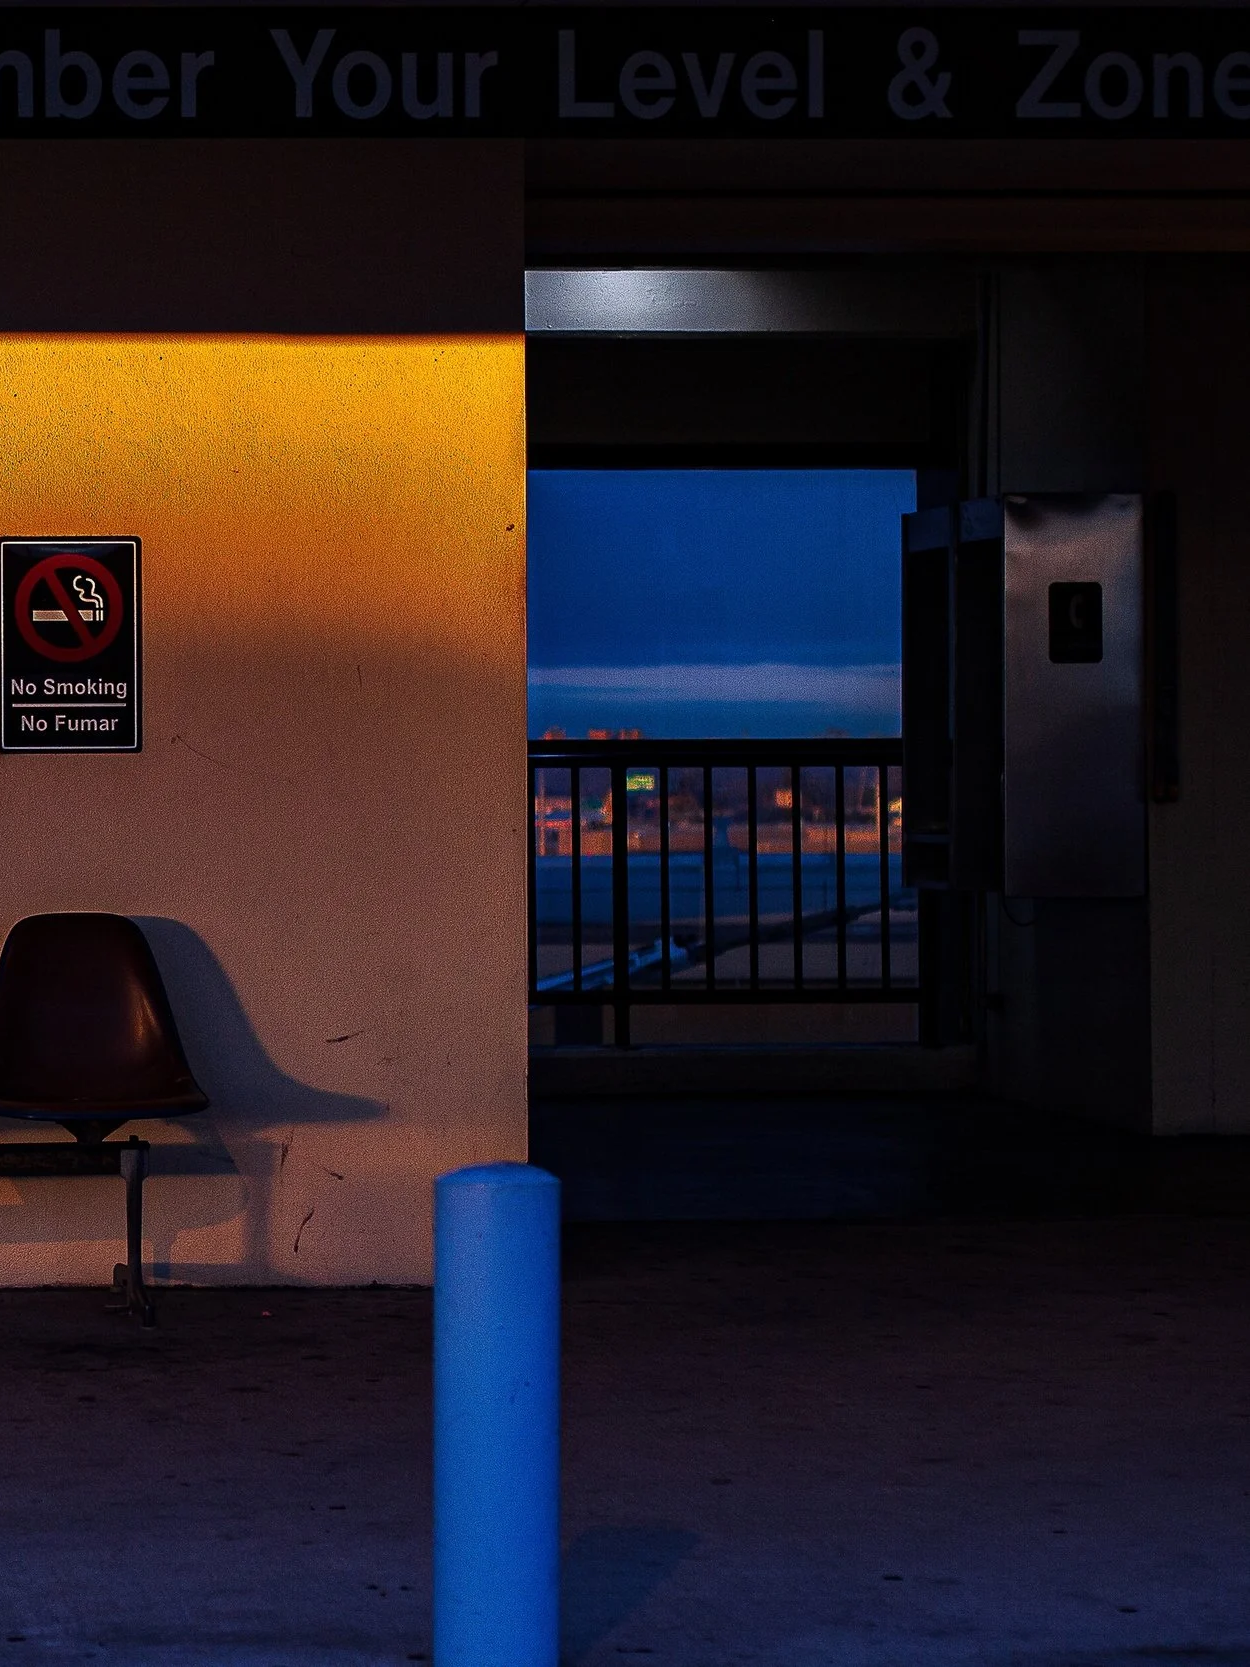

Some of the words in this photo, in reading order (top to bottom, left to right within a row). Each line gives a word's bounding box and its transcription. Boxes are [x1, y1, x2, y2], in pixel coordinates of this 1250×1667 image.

[269, 29, 498, 120] Your
[558, 29, 824, 120] Level
[887, 28, 952, 120] &
[1016, 30, 1250, 120] Zone
[11, 678, 37, 695] No
[43, 678, 127, 699] Smoking
[21, 714, 48, 732] No
[55, 714, 119, 732] Fumar
